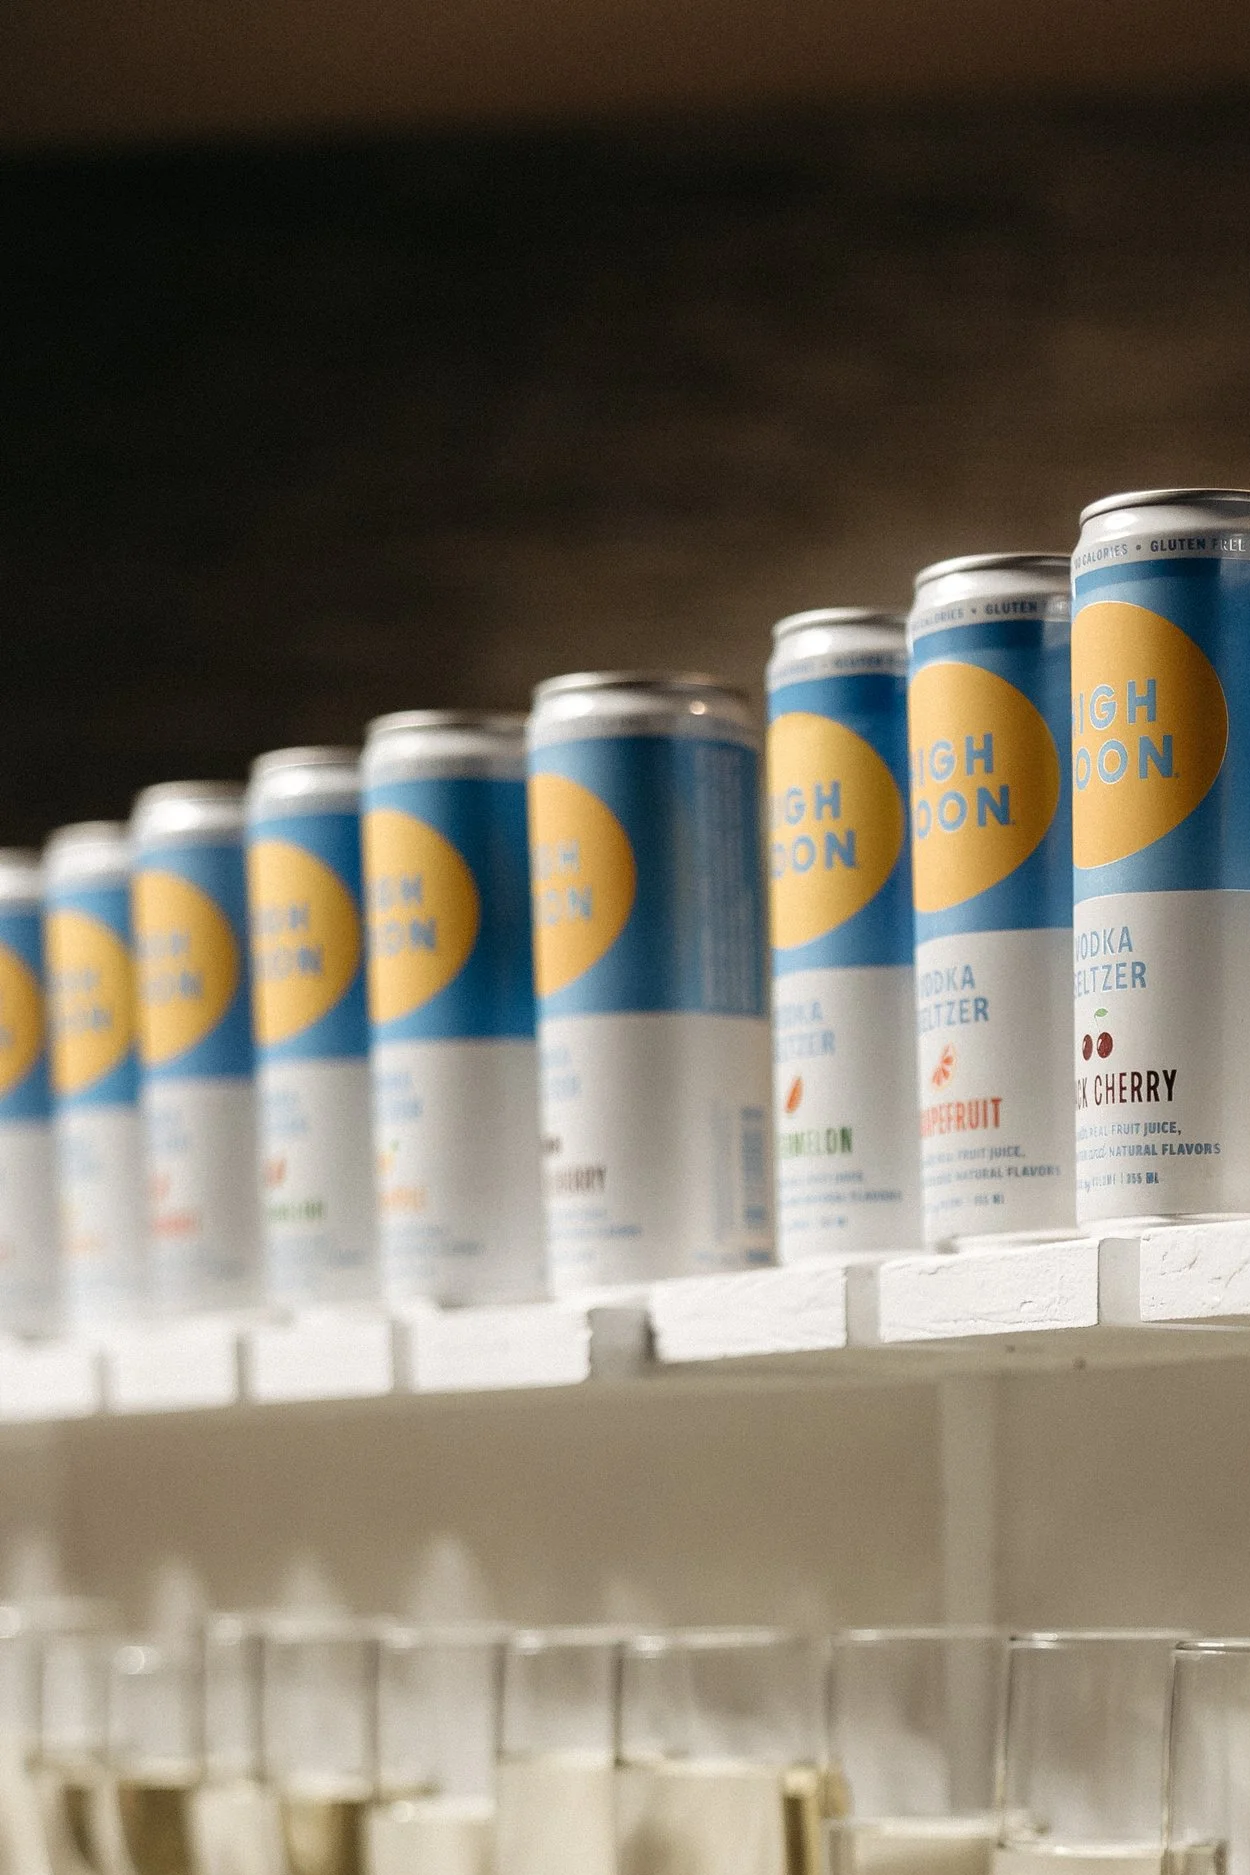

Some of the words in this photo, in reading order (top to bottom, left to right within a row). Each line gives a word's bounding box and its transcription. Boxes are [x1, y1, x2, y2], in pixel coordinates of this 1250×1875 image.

[1150, 539, 1206, 552] GLUTEN
[1075, 734, 1174, 790] OON
[915, 784, 1011, 839] OON
[771, 829, 858, 880] OON
[1094, 1069, 1178, 1107] CHERRY
[1111, 1122, 1141, 1136] FRUIT
[1143, 1121, 1182, 1137] JUICE,
[1109, 1144, 1158, 1158] NATURAL
[1162, 1142, 1221, 1156] FLAVORS
